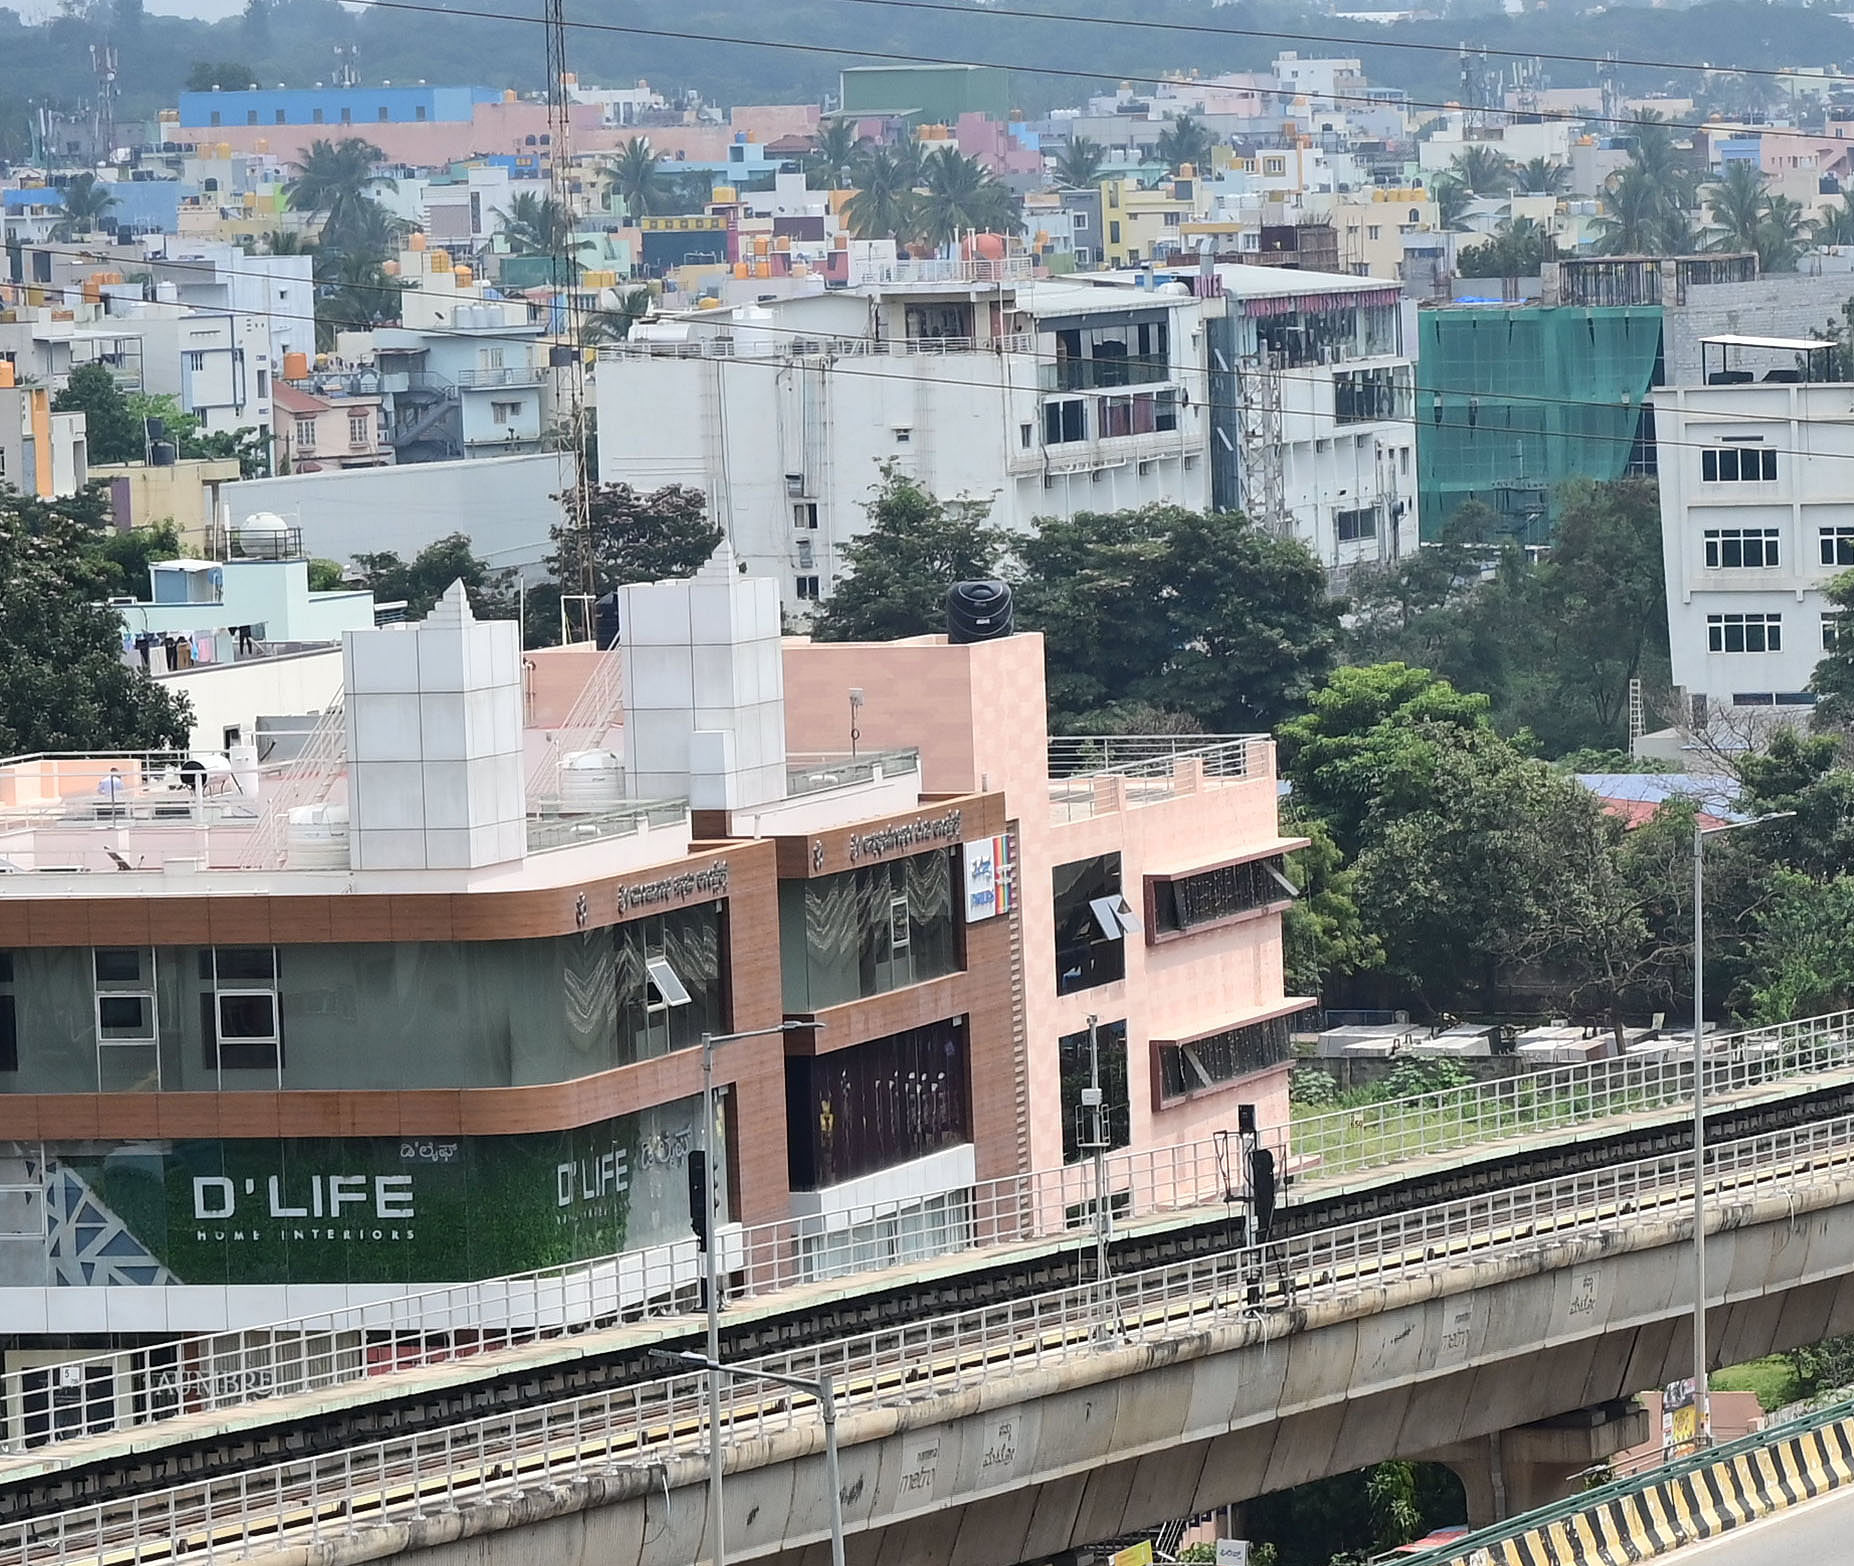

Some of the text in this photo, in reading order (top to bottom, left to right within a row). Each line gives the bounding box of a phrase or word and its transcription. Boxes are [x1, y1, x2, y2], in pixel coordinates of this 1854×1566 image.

[1193, 273, 1224, 297] HOTEL
[557, 1148, 629, 1208] D'LIFE
[192, 1175, 416, 1220] D'LIFE
[196, 1229, 416, 1243] HOME INTERIORS
